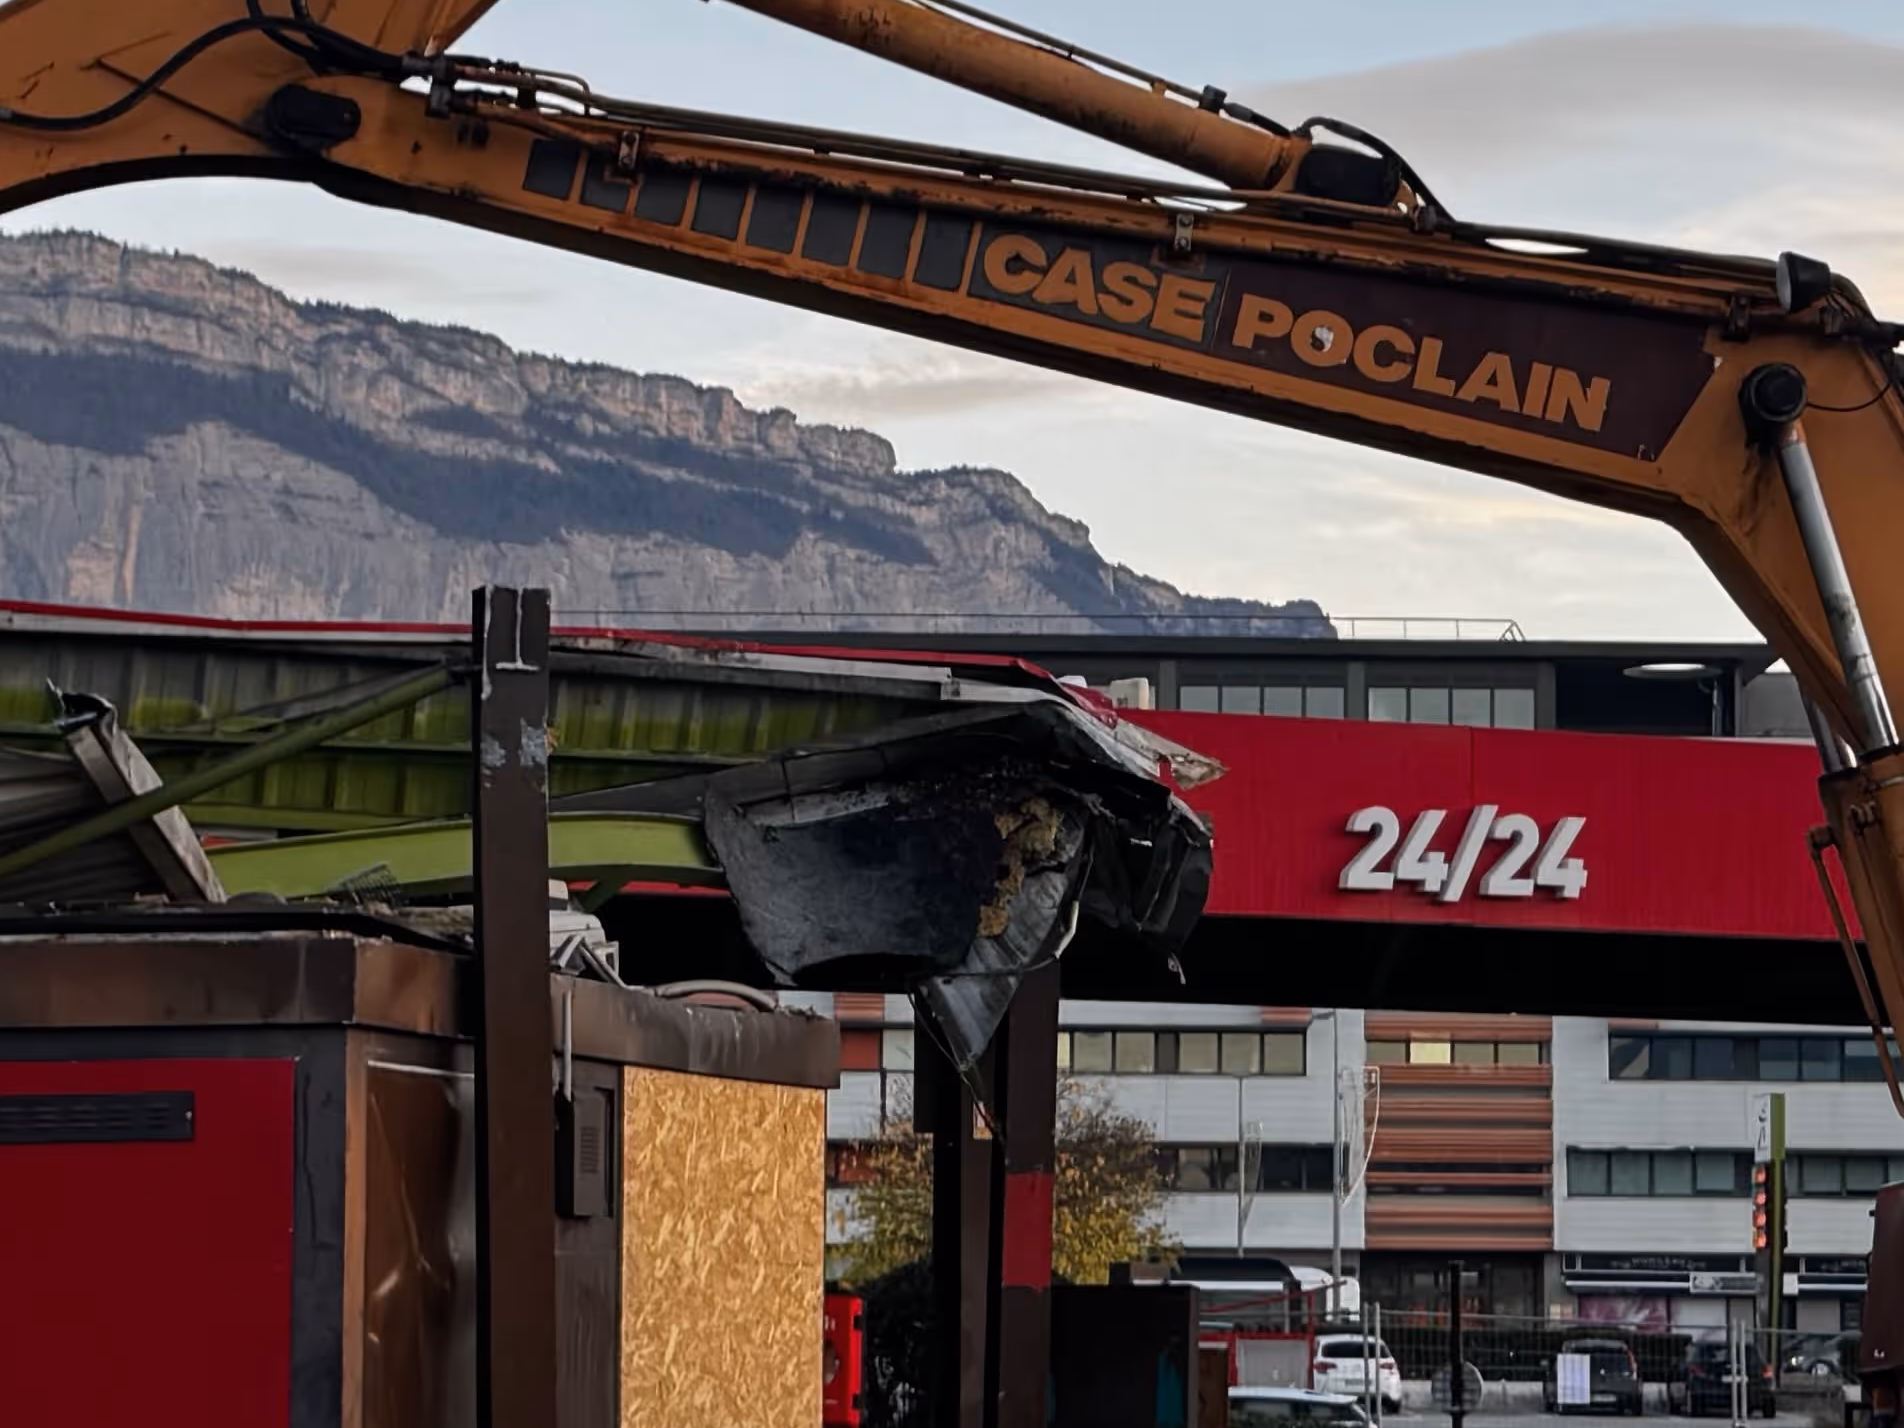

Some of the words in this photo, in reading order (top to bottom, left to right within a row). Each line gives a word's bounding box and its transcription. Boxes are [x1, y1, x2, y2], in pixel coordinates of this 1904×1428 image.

[983, 233, 1217, 342] CASE
[1232, 293, 1610, 431] POCLAIN
[1339, 804, 1588, 902] 24/24
